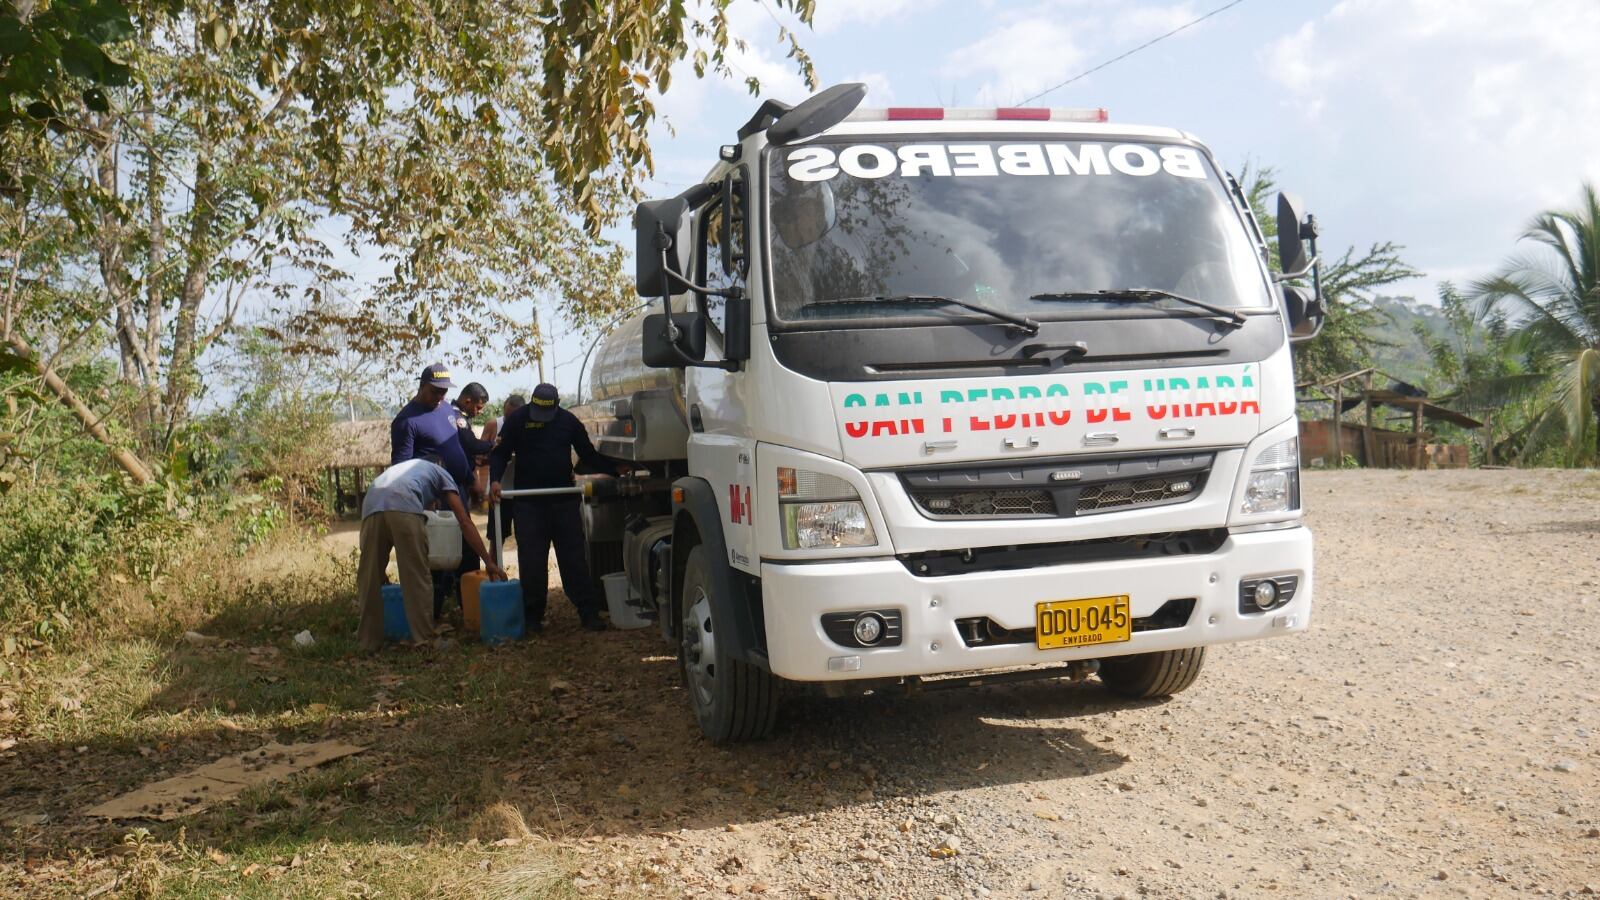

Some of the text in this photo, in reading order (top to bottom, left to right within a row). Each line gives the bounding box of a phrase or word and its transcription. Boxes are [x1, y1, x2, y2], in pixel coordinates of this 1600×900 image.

[844, 365, 1261, 438] SAN PEDRO DE URABÁ
